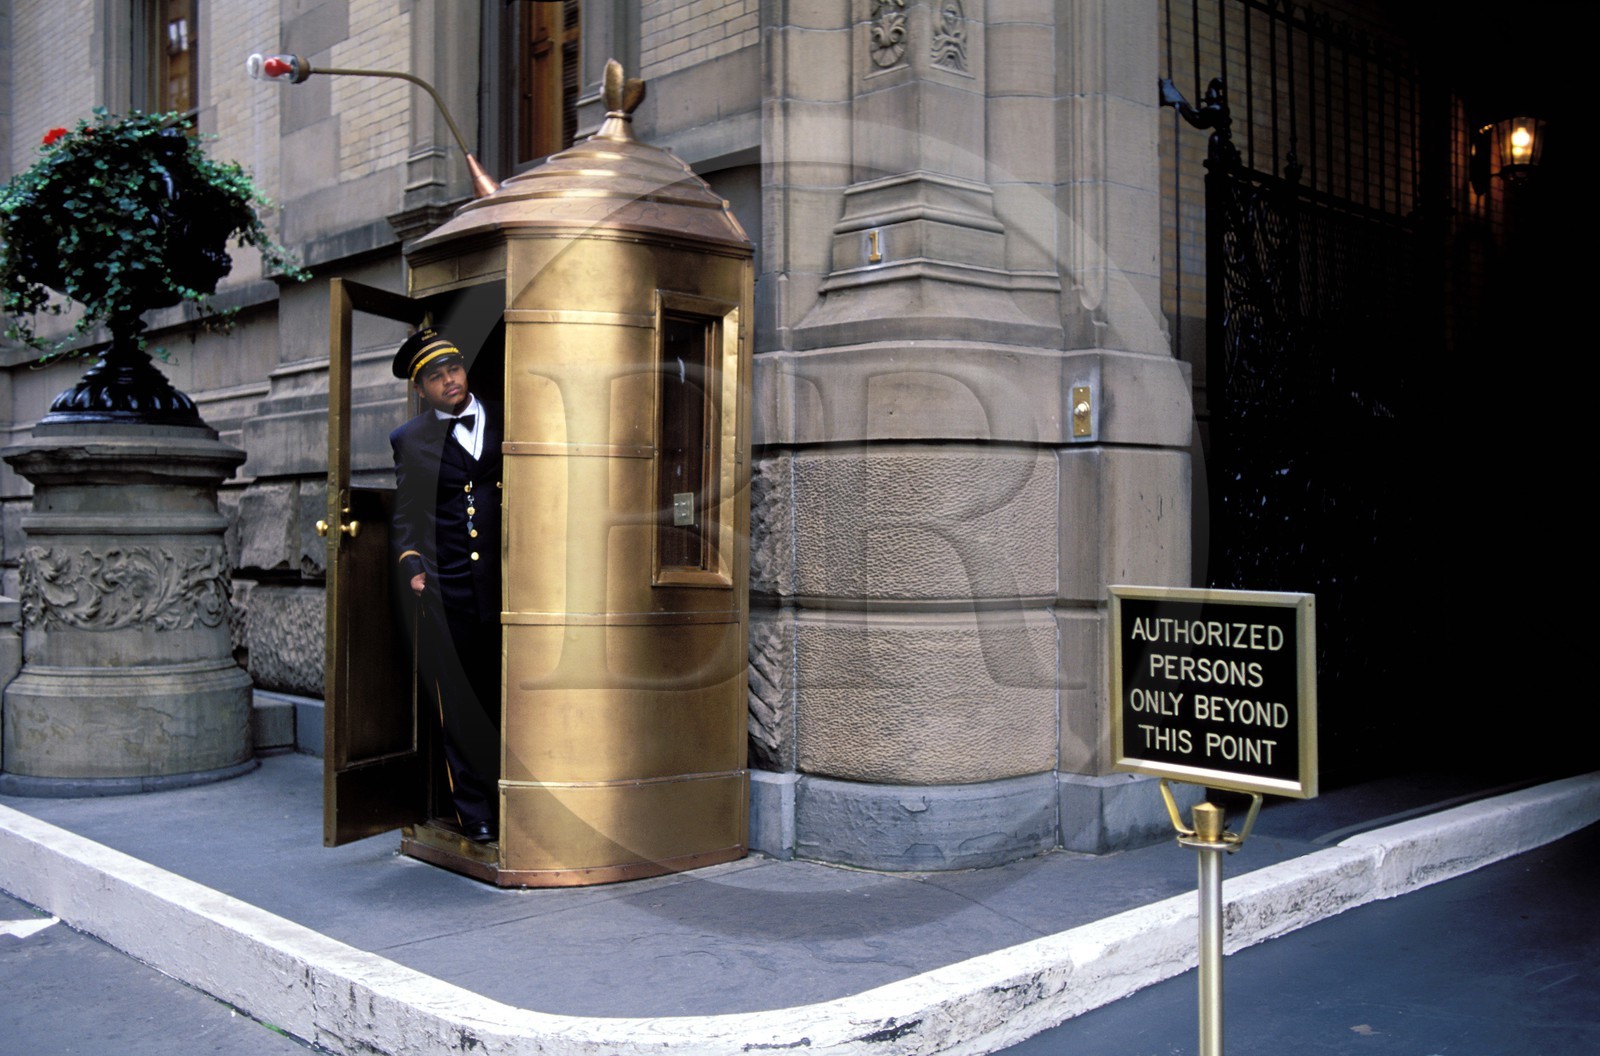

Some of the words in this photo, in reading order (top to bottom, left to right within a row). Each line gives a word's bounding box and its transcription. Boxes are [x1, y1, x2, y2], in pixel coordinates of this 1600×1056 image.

[868, 230, 882, 262] 1
[1132, 618, 1283, 650] AUTHORIZED
[1150, 654, 1263, 687] PERSONS
[1131, 689, 1183, 716] ONLY
[1195, 695, 1288, 728] BEYOND
[1138, 725, 1192, 753] THIS
[1207, 733, 1276, 764] POINT
